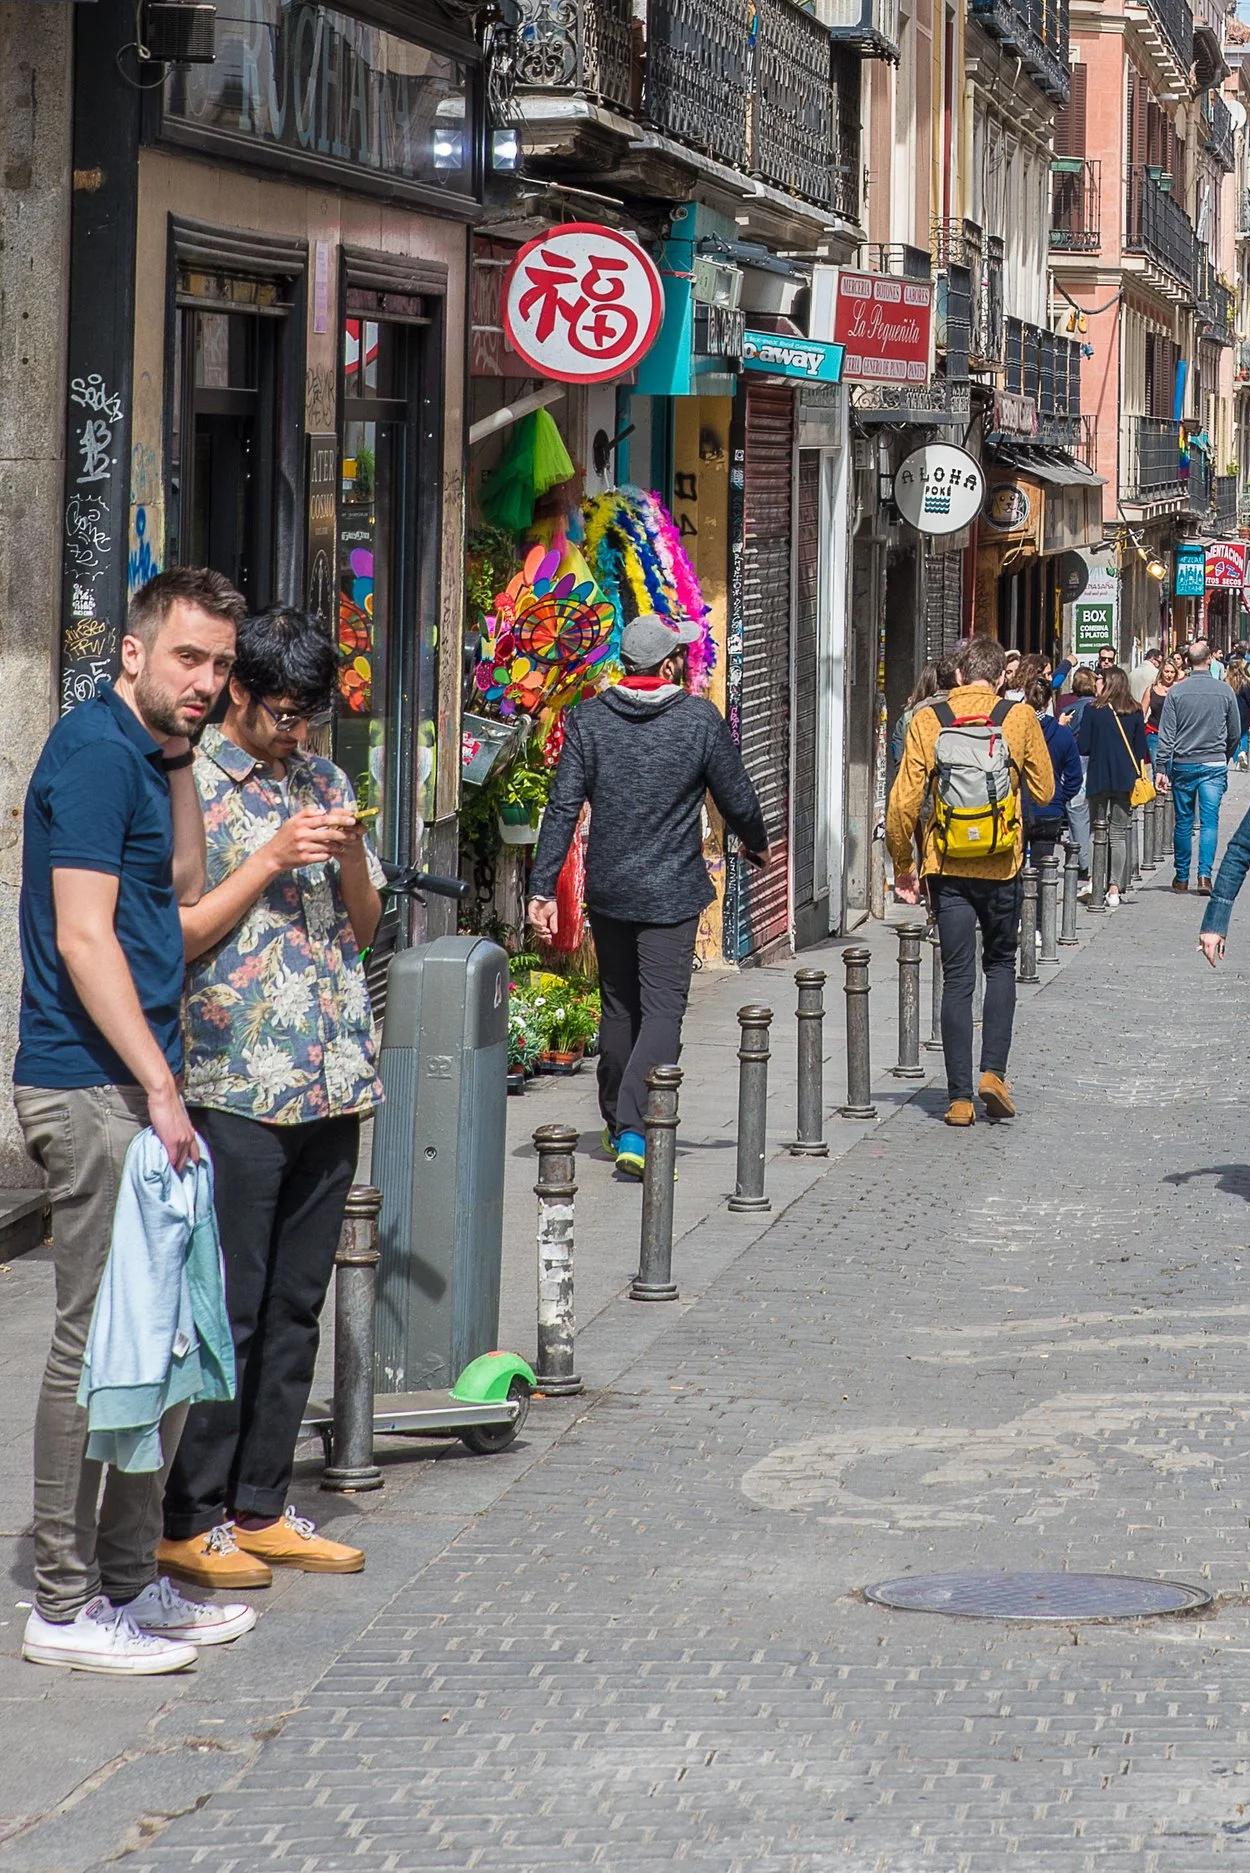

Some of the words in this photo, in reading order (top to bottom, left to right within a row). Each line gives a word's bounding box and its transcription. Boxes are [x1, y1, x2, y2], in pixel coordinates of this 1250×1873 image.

[518, 248, 639, 360] 福
[867, 303, 920, 353] Pequeñita
[901, 466, 977, 491] ALOHA
[1083, 610, 1107, 623] BOX
[1085, 631, 1109, 639] PLATOS
